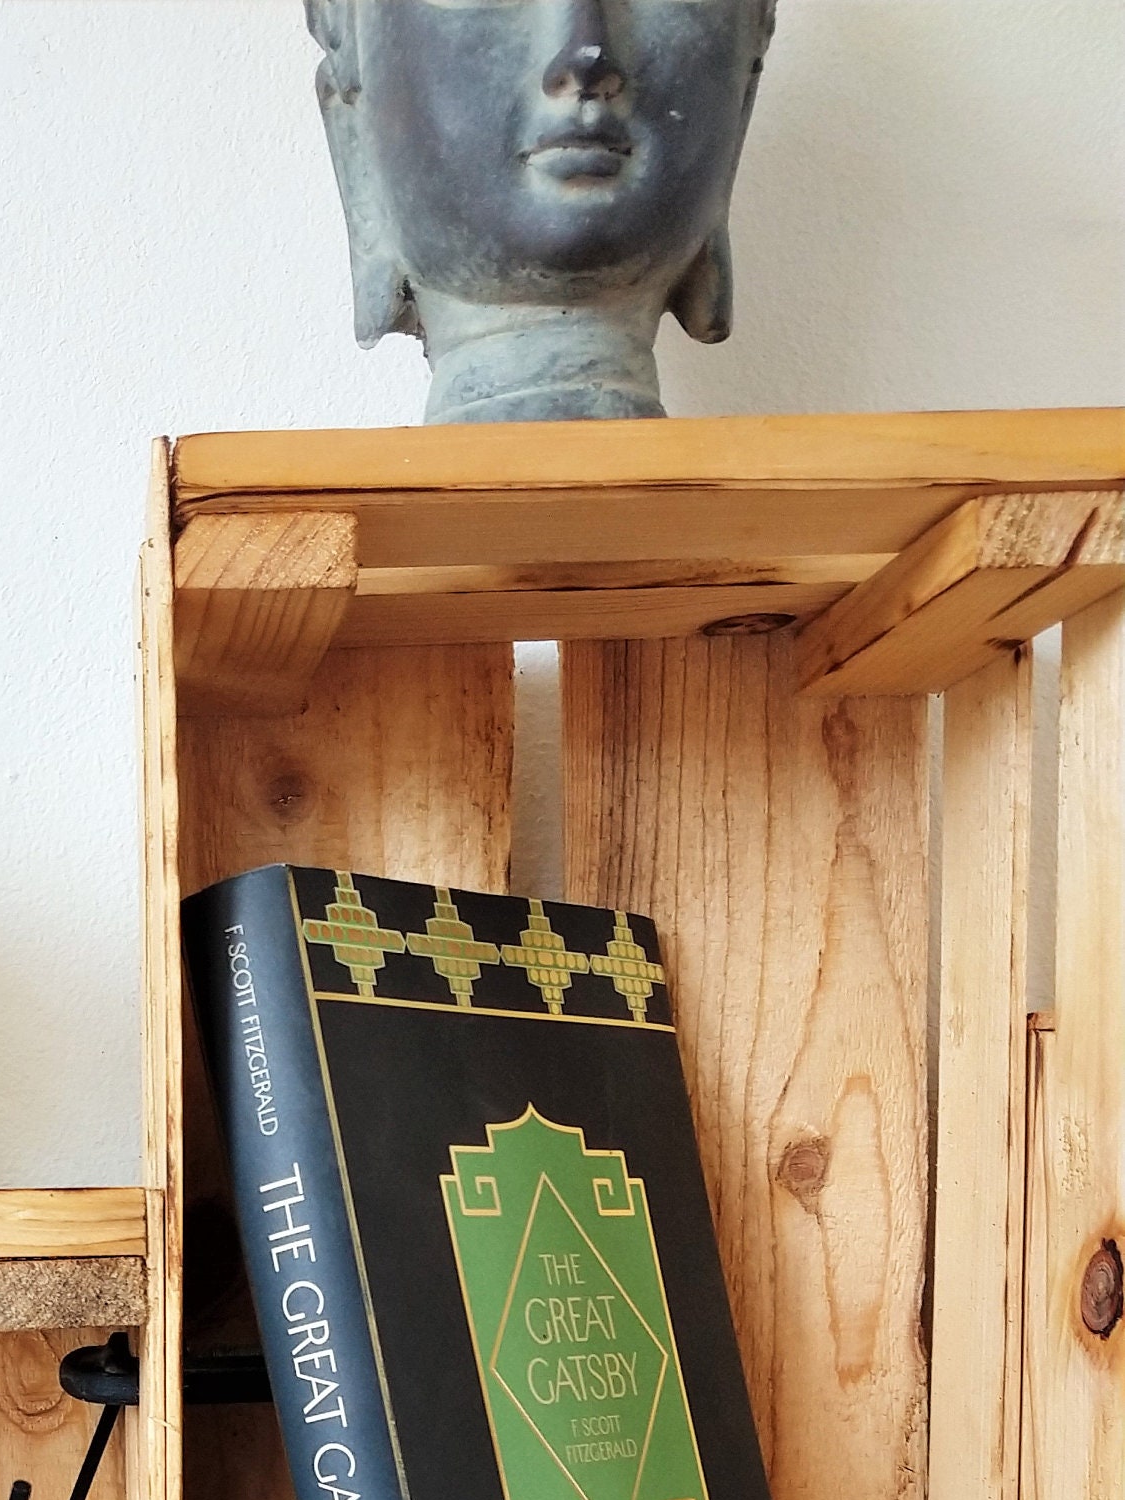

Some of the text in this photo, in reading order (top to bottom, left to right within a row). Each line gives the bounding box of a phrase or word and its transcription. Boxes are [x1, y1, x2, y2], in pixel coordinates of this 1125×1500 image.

[224, 924, 279, 1136] F. SCOTT FITZGERALD
[259, 1163, 317, 1273] THE
[538, 1253, 586, 1286] THE
[525, 1295, 617, 1344] GREAT
[282, 1280, 348, 1427] GREAT
[527, 1351, 638, 1405] GATSBY
[565, 1438, 638, 1465] FITZGERALD
[581, 1414, 621, 1438] SCOTT
